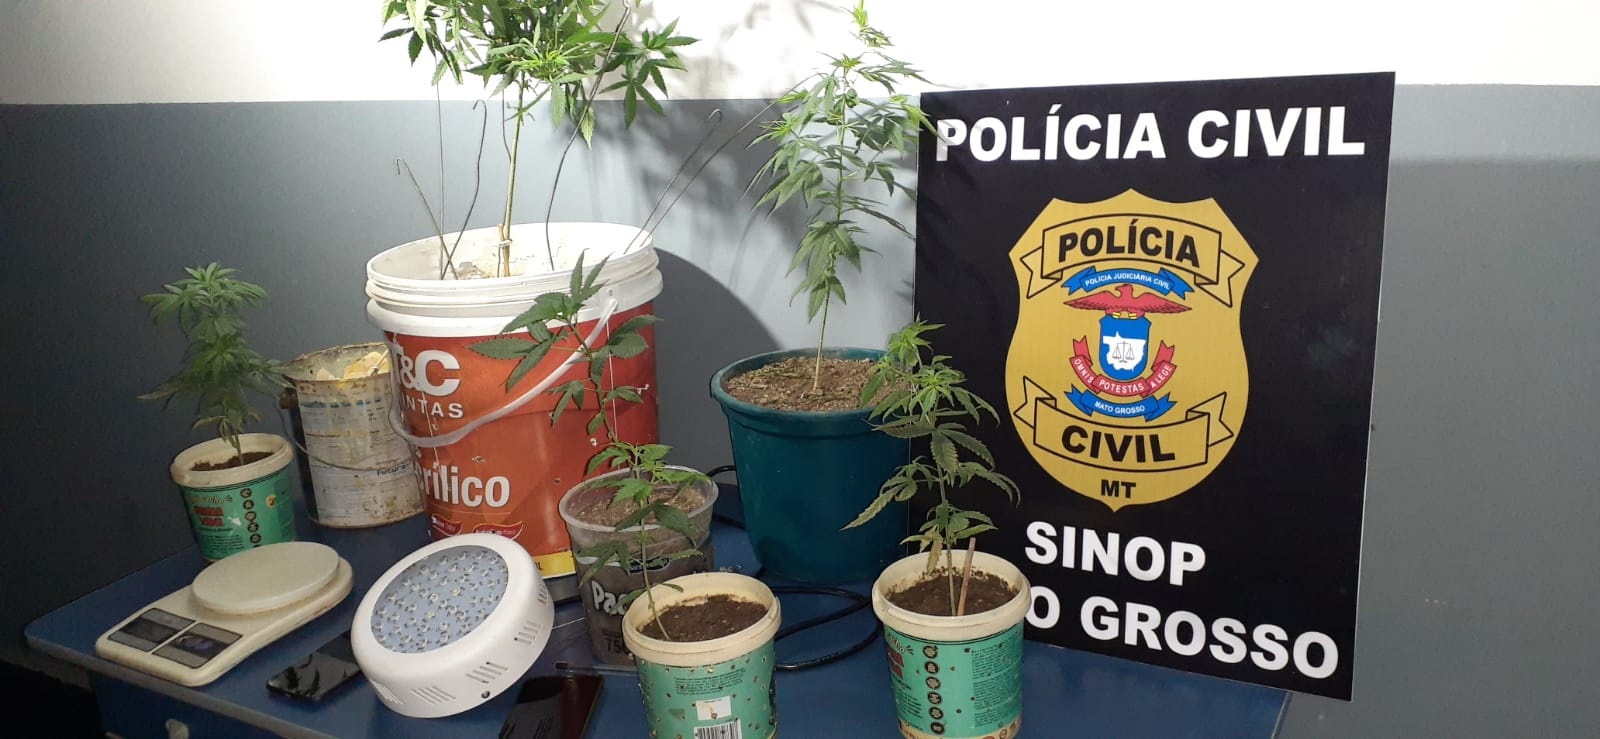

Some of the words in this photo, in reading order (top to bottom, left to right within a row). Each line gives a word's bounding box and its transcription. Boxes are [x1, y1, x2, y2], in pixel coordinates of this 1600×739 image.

[936, 104, 1166, 162] POLÍCIA
[1187, 106, 1366, 158] CIVIL
[1058, 218, 1200, 268] POLÍCIA
[1085, 274, 1112, 286] POLÍCIA
[1113, 273, 1152, 283] JUDICIÁRIA
[1153, 278, 1170, 290] CIVIL
[1074, 359, 1095, 384] OMNIS
[1098, 379, 1145, 394] POTESTAS
[1155, 364, 1172, 384] LEGE
[1094, 400, 1113, 412] MATO
[1114, 406, 1145, 414] GROSSO
[1061, 425, 1176, 463] CIVIL
[1100, 479, 1137, 499] MT
[1024, 521, 1206, 586] SINOP
[1025, 585, 1061, 629] O
[1080, 596, 1339, 679] GROSSO
